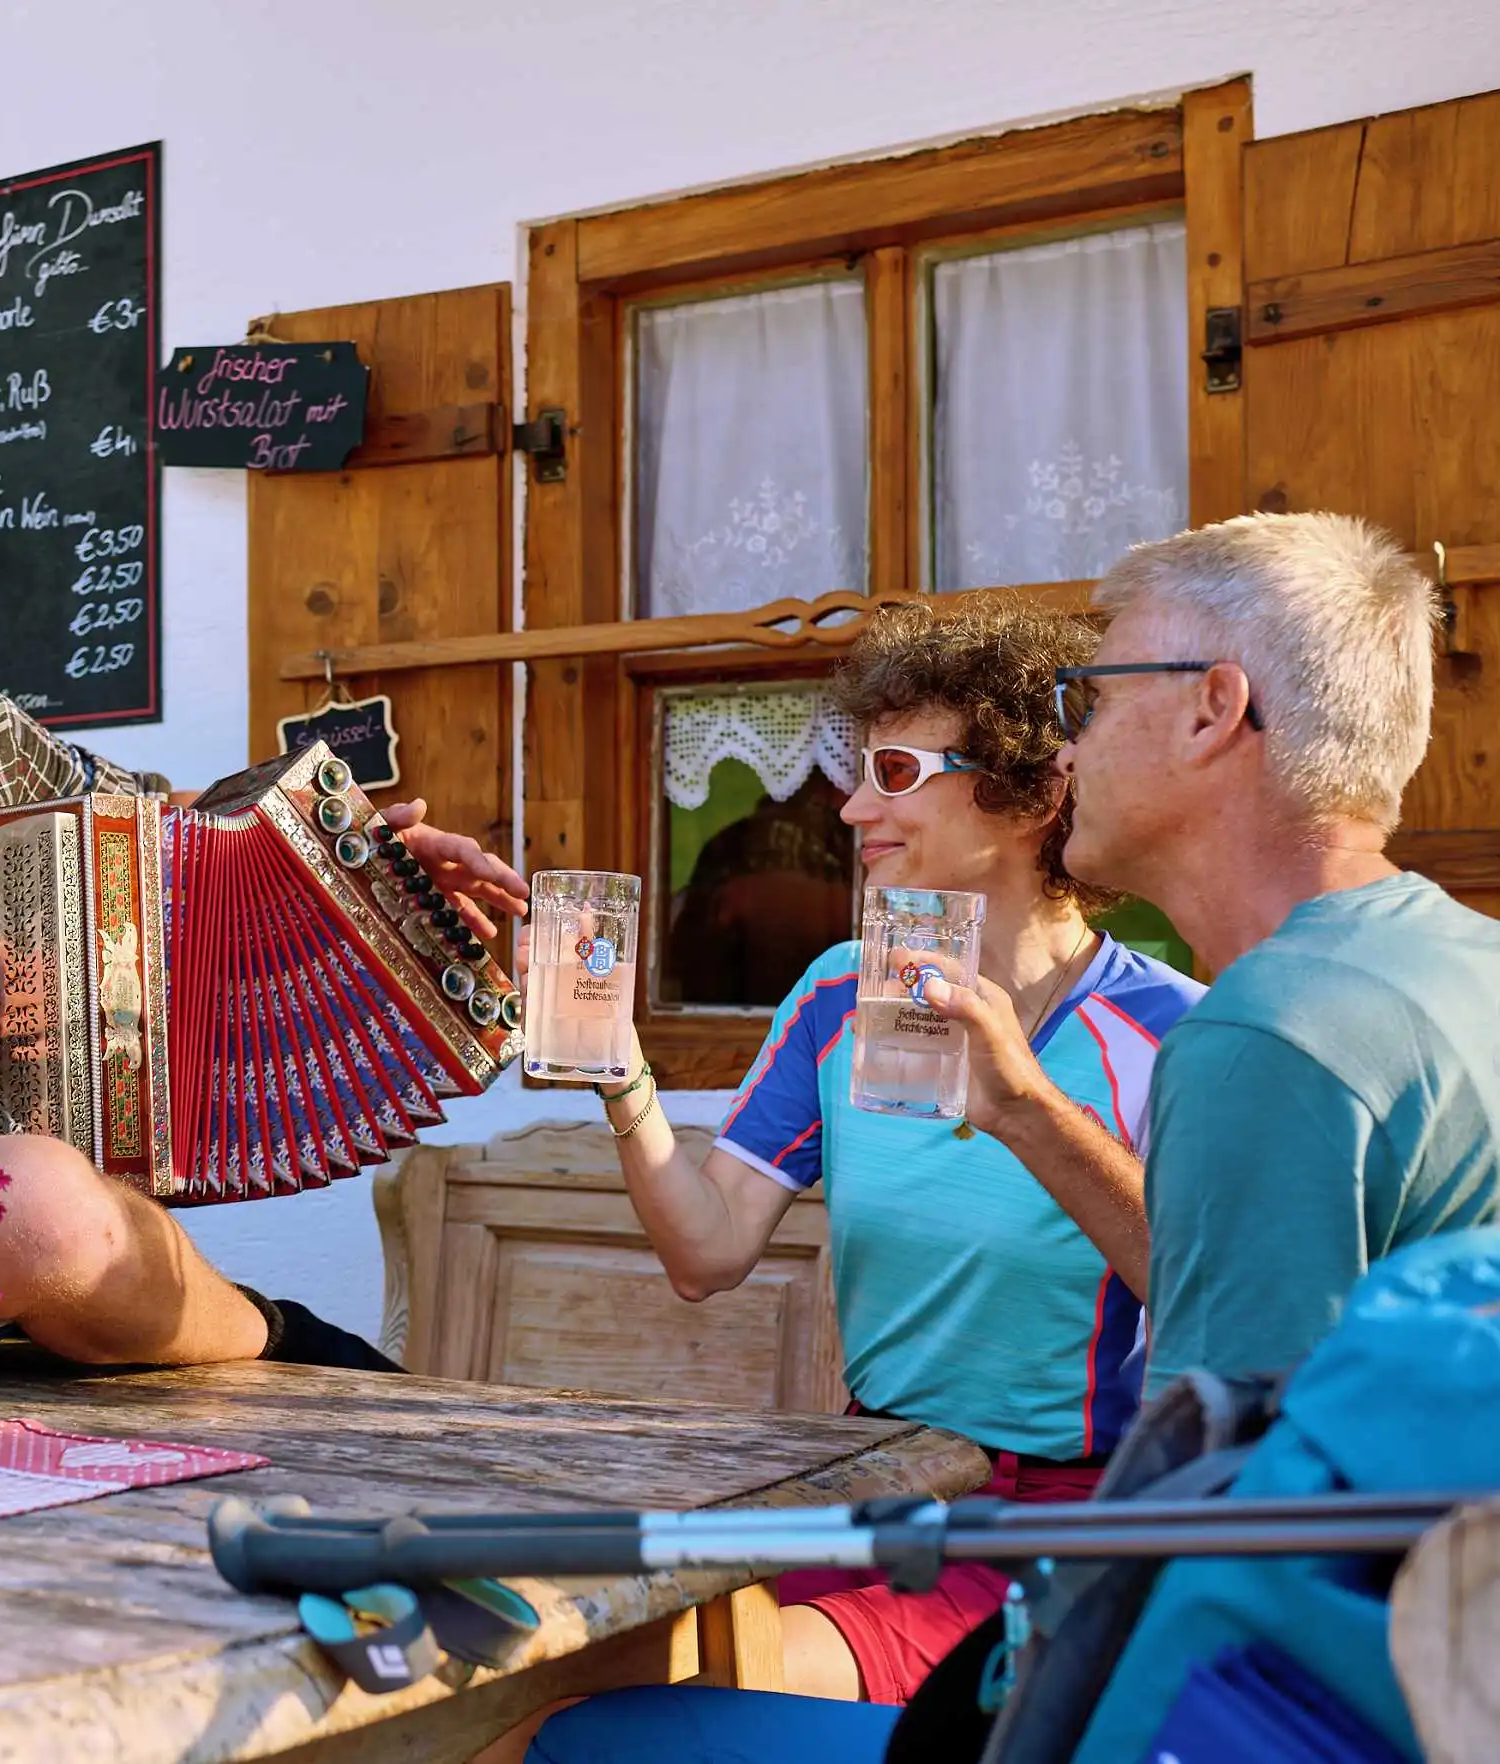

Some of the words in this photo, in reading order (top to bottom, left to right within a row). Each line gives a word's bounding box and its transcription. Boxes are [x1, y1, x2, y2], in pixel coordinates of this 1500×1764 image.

[6, 367, 52, 412] Ruß
[157, 385, 303, 431] Wurstsalat
[305, 393, 349, 424] mit
[246, 432, 312, 470] Brot
[20, 491, 61, 531] Wein
[74, 524, 145, 563] €3,50
[71, 560, 144, 596] €2,50
[68, 597, 144, 637] €2,50
[64, 642, 135, 680] €2,50
